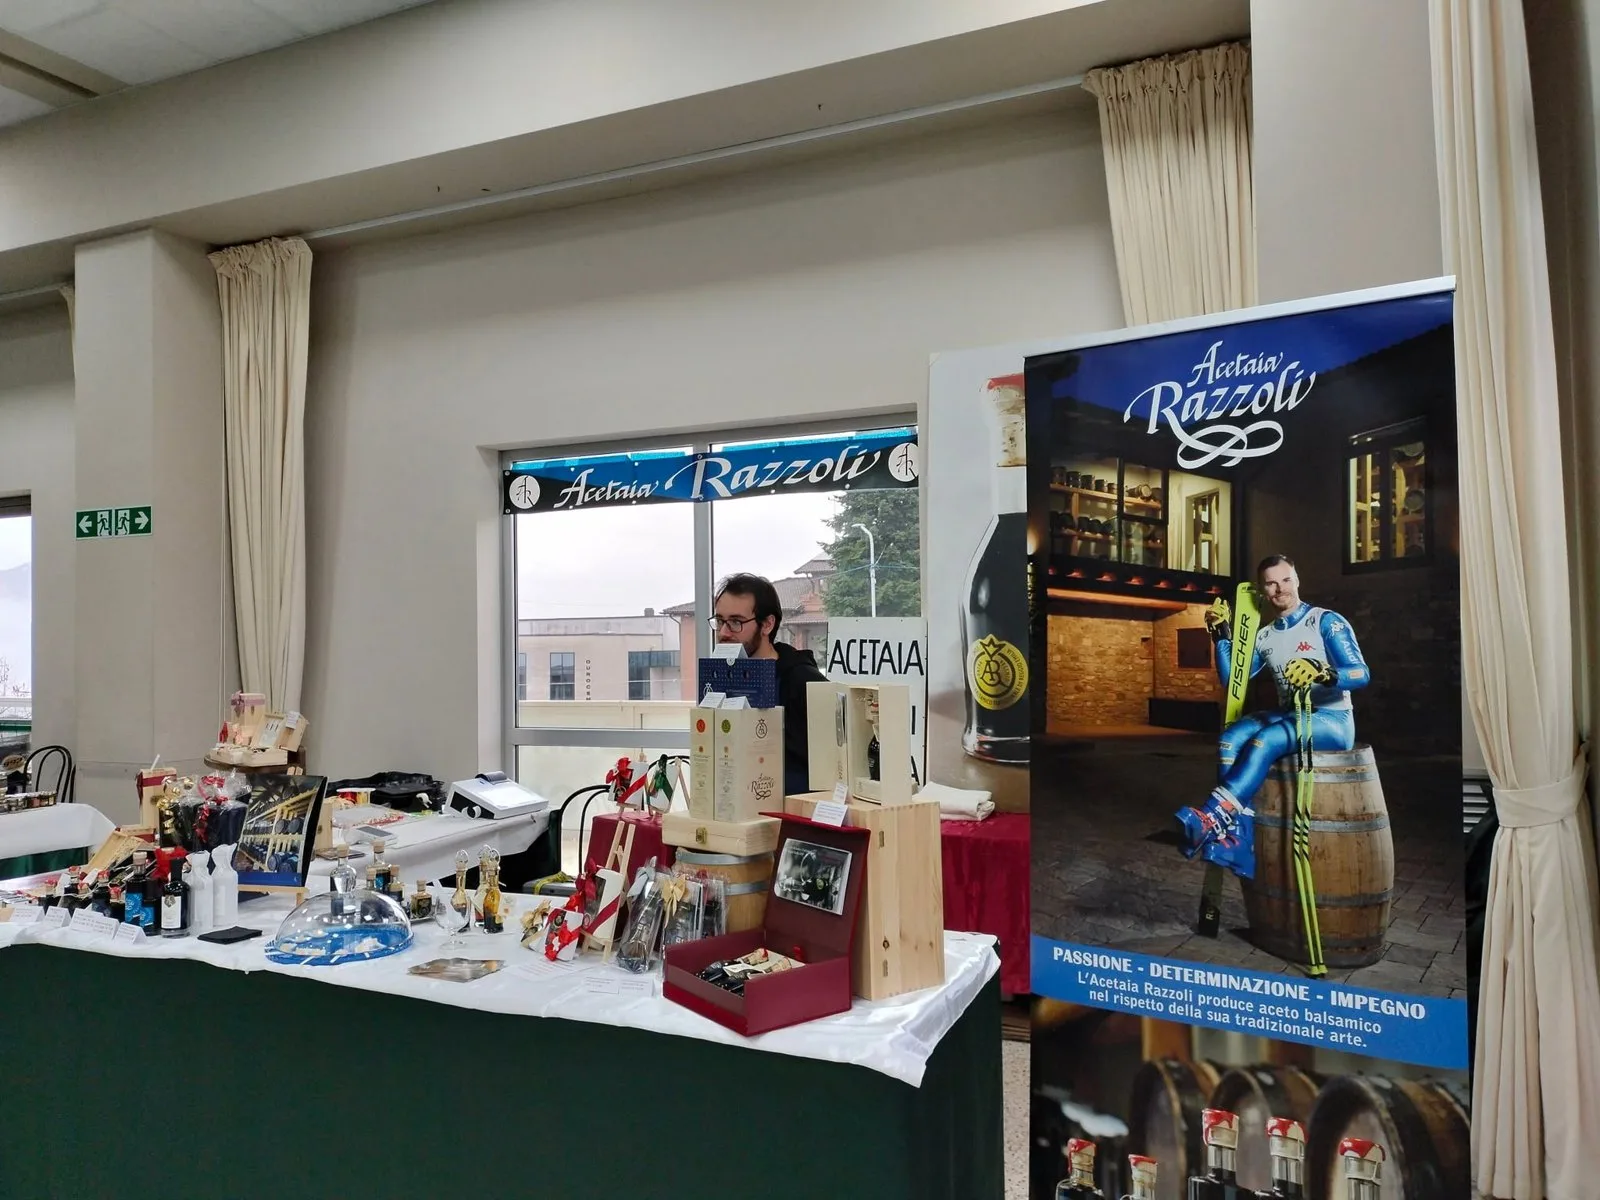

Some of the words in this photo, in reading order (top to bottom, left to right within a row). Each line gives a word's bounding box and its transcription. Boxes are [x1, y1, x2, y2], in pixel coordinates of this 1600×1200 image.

[1187, 340, 1283, 388] Acetaia
[1123, 361, 1317, 469] Razzoli
[554, 468, 660, 508] Acetaia
[665, 445, 881, 499] Razzoli
[828, 639, 924, 675] ACETAIA
[1231, 613, 1251, 701] FISCHER
[1053, 946, 1133, 973] PASSIONE
[1149, 962, 1310, 1001] DETERMINAZIONE
[1330, 990, 1426, 1019] IMPEGNO
[1078, 970, 1139, 993] L'Acetaia
[1144, 982, 1193, 1002] Razzoli
[1198, 992, 1254, 1012] produce
[1259, 1002, 1299, 1020] aceto
[1305, 1008, 1382, 1034] balsamico
[1089, 990, 1109, 1002] nel
[1113, 993, 1164, 1012] rispetto
[1168, 1001, 1202, 1020] della
[1206, 1009, 1230, 1024] sua
[1235, 1013, 1324, 1040] tradizionale
[1329, 1030, 1368, 1047] arte.
